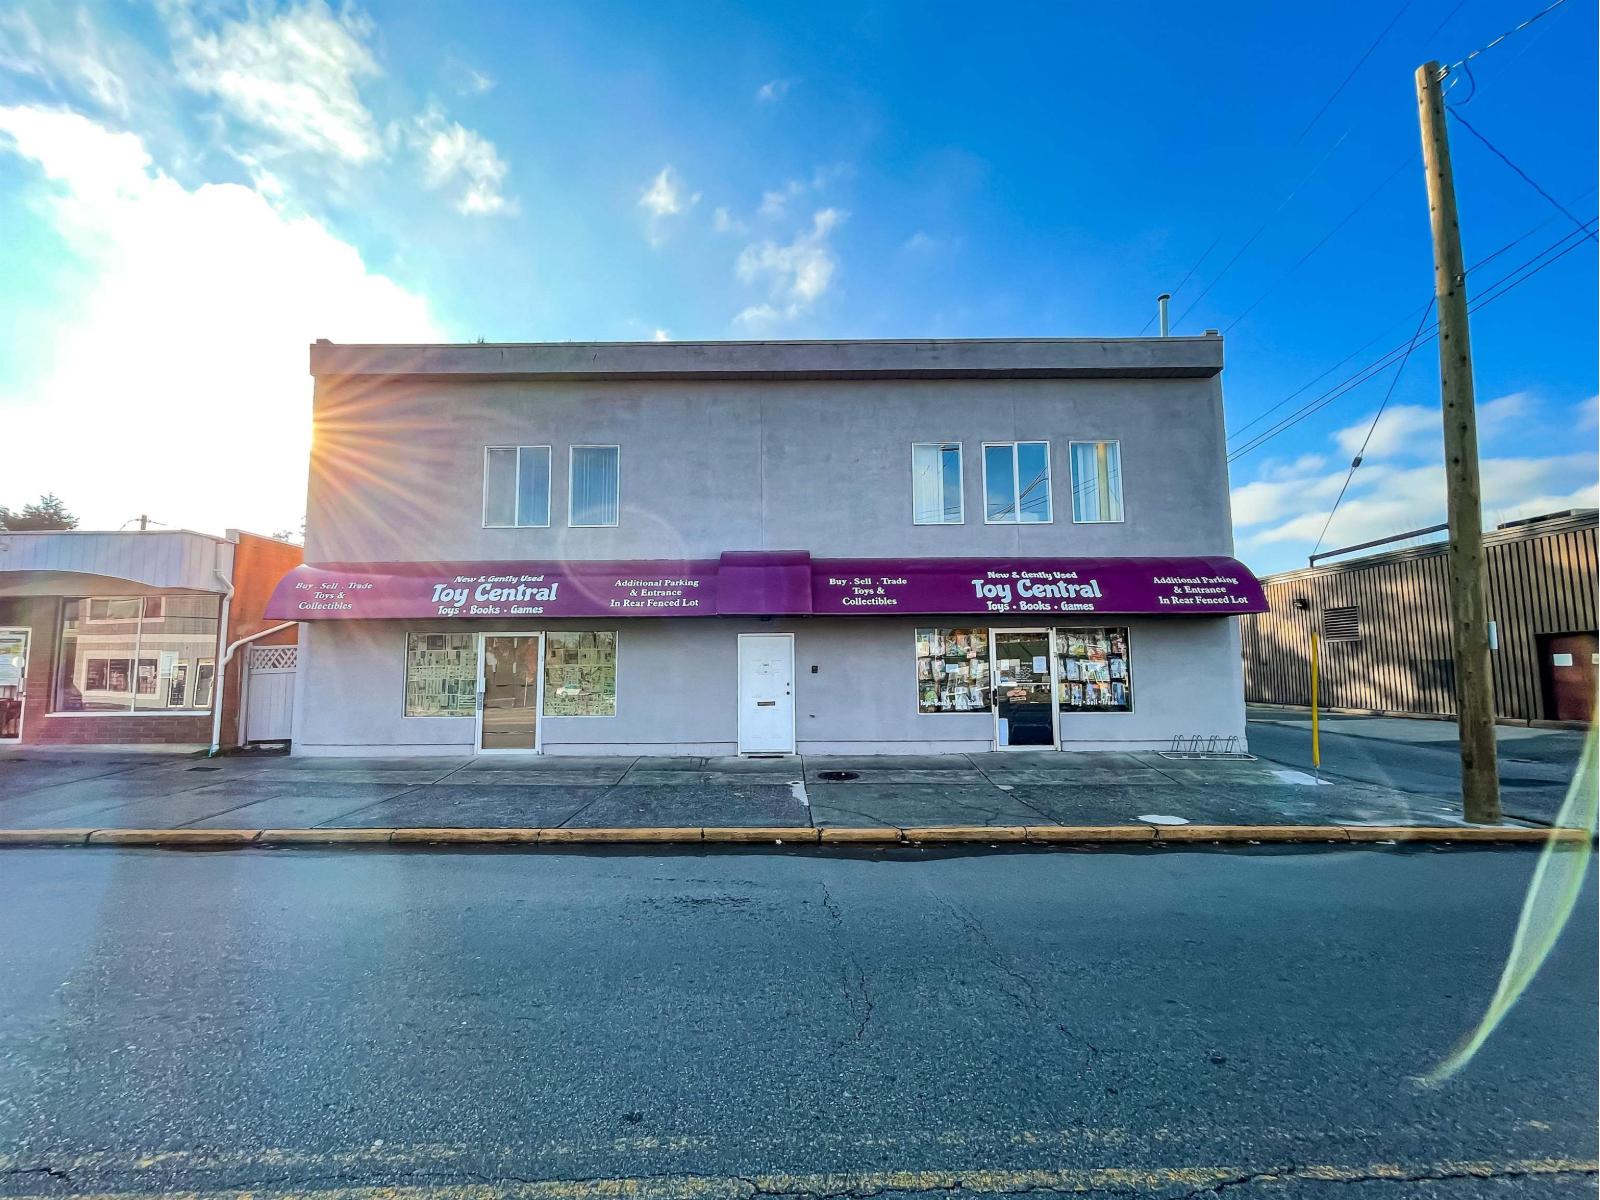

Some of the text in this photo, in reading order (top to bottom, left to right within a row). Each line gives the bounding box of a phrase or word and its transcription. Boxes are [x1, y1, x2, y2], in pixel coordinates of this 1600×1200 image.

[454, 574, 545, 584] New & Gently Used
[987, 571, 1078, 580] New & Gently Used
[1153, 575, 1239, 584] Additional Parking
[295, 582, 314, 590] Buy
[320, 582, 339, 590] Sell
[614, 579, 699, 588] Additional Parking
[829, 577, 908, 586] Buy Sell Trade
[629, 588, 682, 597] & Entrance
[852, 586, 885, 596] Toys &
[971, 578, 1103, 603] Toy Central
[1173, 585, 1227, 594] & Entrance
[313, 591, 346, 600] Toys &
[431, 582, 559, 607] Toy Central
[609, 598, 699, 607] In Rear Fenced Lot
[842, 597, 898, 606] Collectibles
[1158, 595, 1249, 605] In Rear Fenced Lot
[298, 601, 353, 610] Collectibles
[986, 600, 1095, 613] Toys Books Games
[437, 605, 544, 617] Toys Books Games
